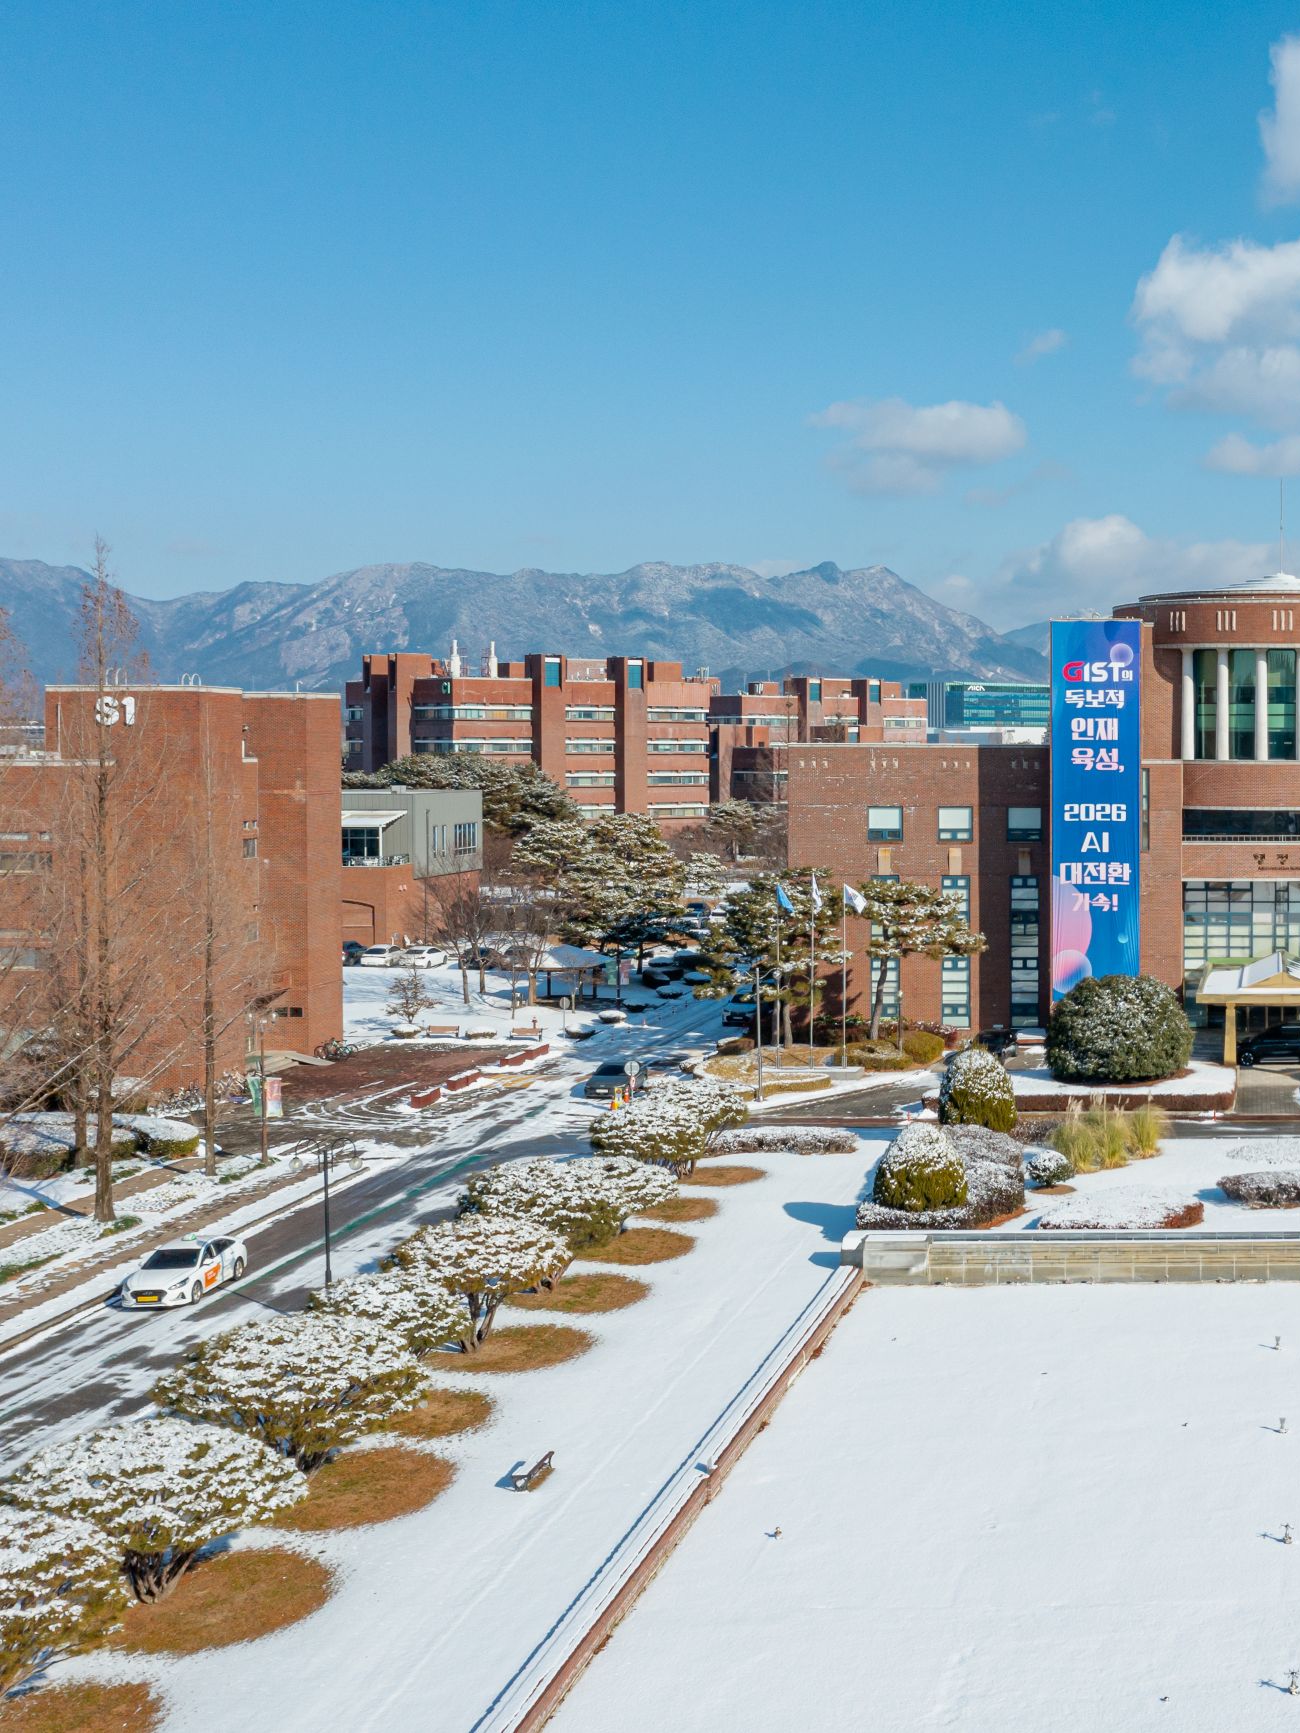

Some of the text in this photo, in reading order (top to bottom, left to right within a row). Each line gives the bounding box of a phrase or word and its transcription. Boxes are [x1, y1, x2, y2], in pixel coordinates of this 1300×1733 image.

[1065, 689, 1125, 709] 독보적
[95, 696, 136, 727] S1
[1071, 718, 1119, 741] 인재
[1071, 747, 1125, 773] 육성,
[1064, 803, 1127, 822] 2026
[1080, 831, 1110, 853] AI
[1059, 862, 1132, 885] 대전환
[1072, 892, 1119, 912] 가속!
